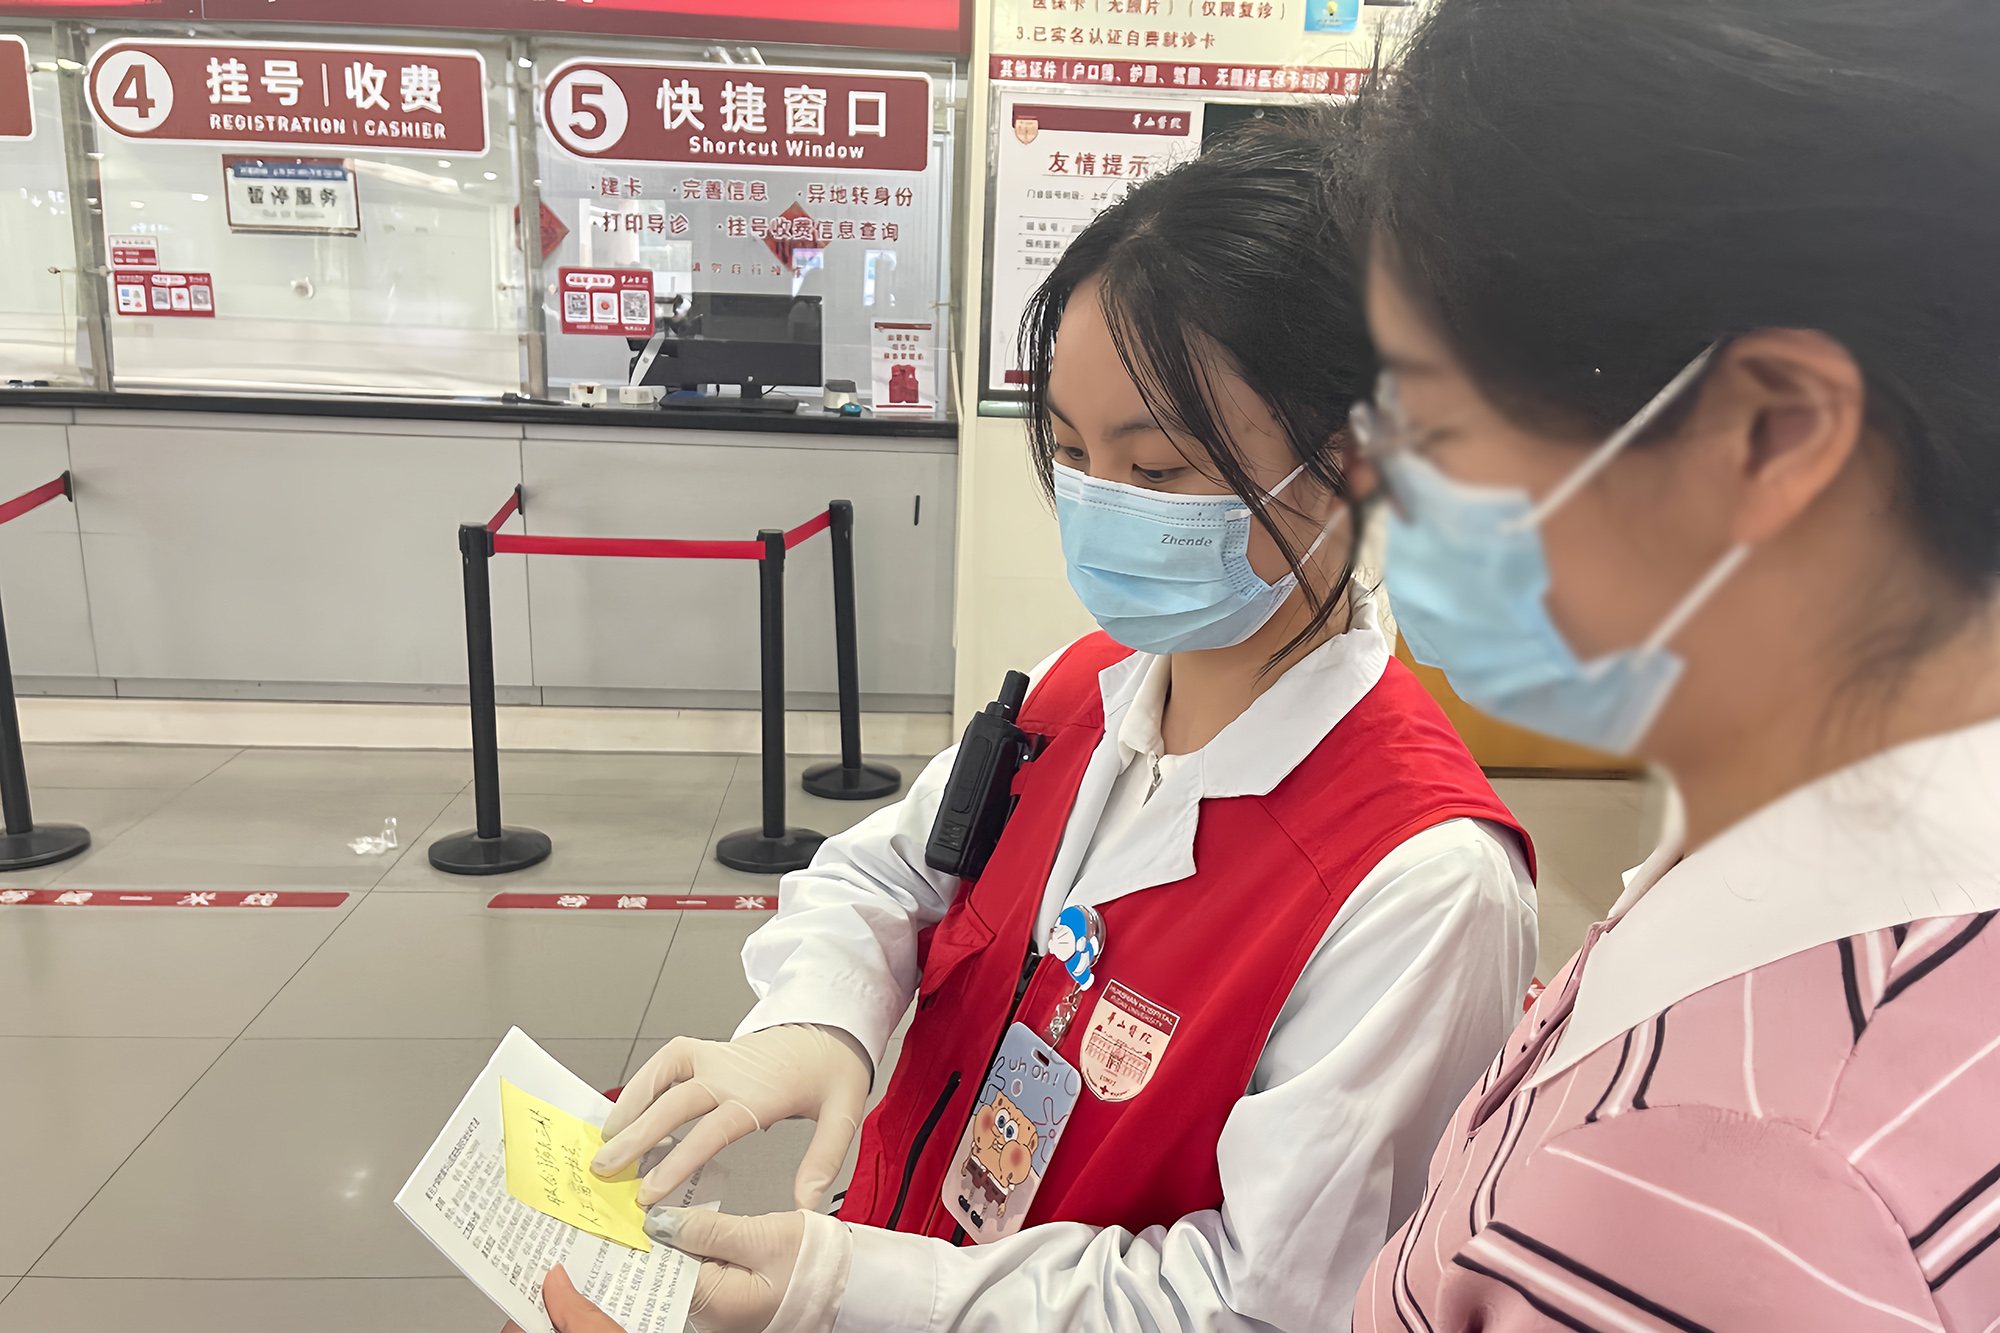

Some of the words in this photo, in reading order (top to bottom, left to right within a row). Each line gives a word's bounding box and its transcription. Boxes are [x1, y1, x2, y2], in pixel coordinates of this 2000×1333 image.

[112, 63, 156, 119] 4
[206, 57, 304, 106] 挂号
[344, 61, 442, 114] 收费
[209, 113, 346, 135] REGISTRATION
[364, 119, 447, 140] CASHIER
[569, 82, 608, 140] 5
[656, 78, 887, 138] 快捷窗口
[689, 136, 778, 156] Shortcut
[786, 140, 865, 159] Window
[1048, 151, 1150, 177] 友情提示
[1161, 533, 1213, 547] Zhende
